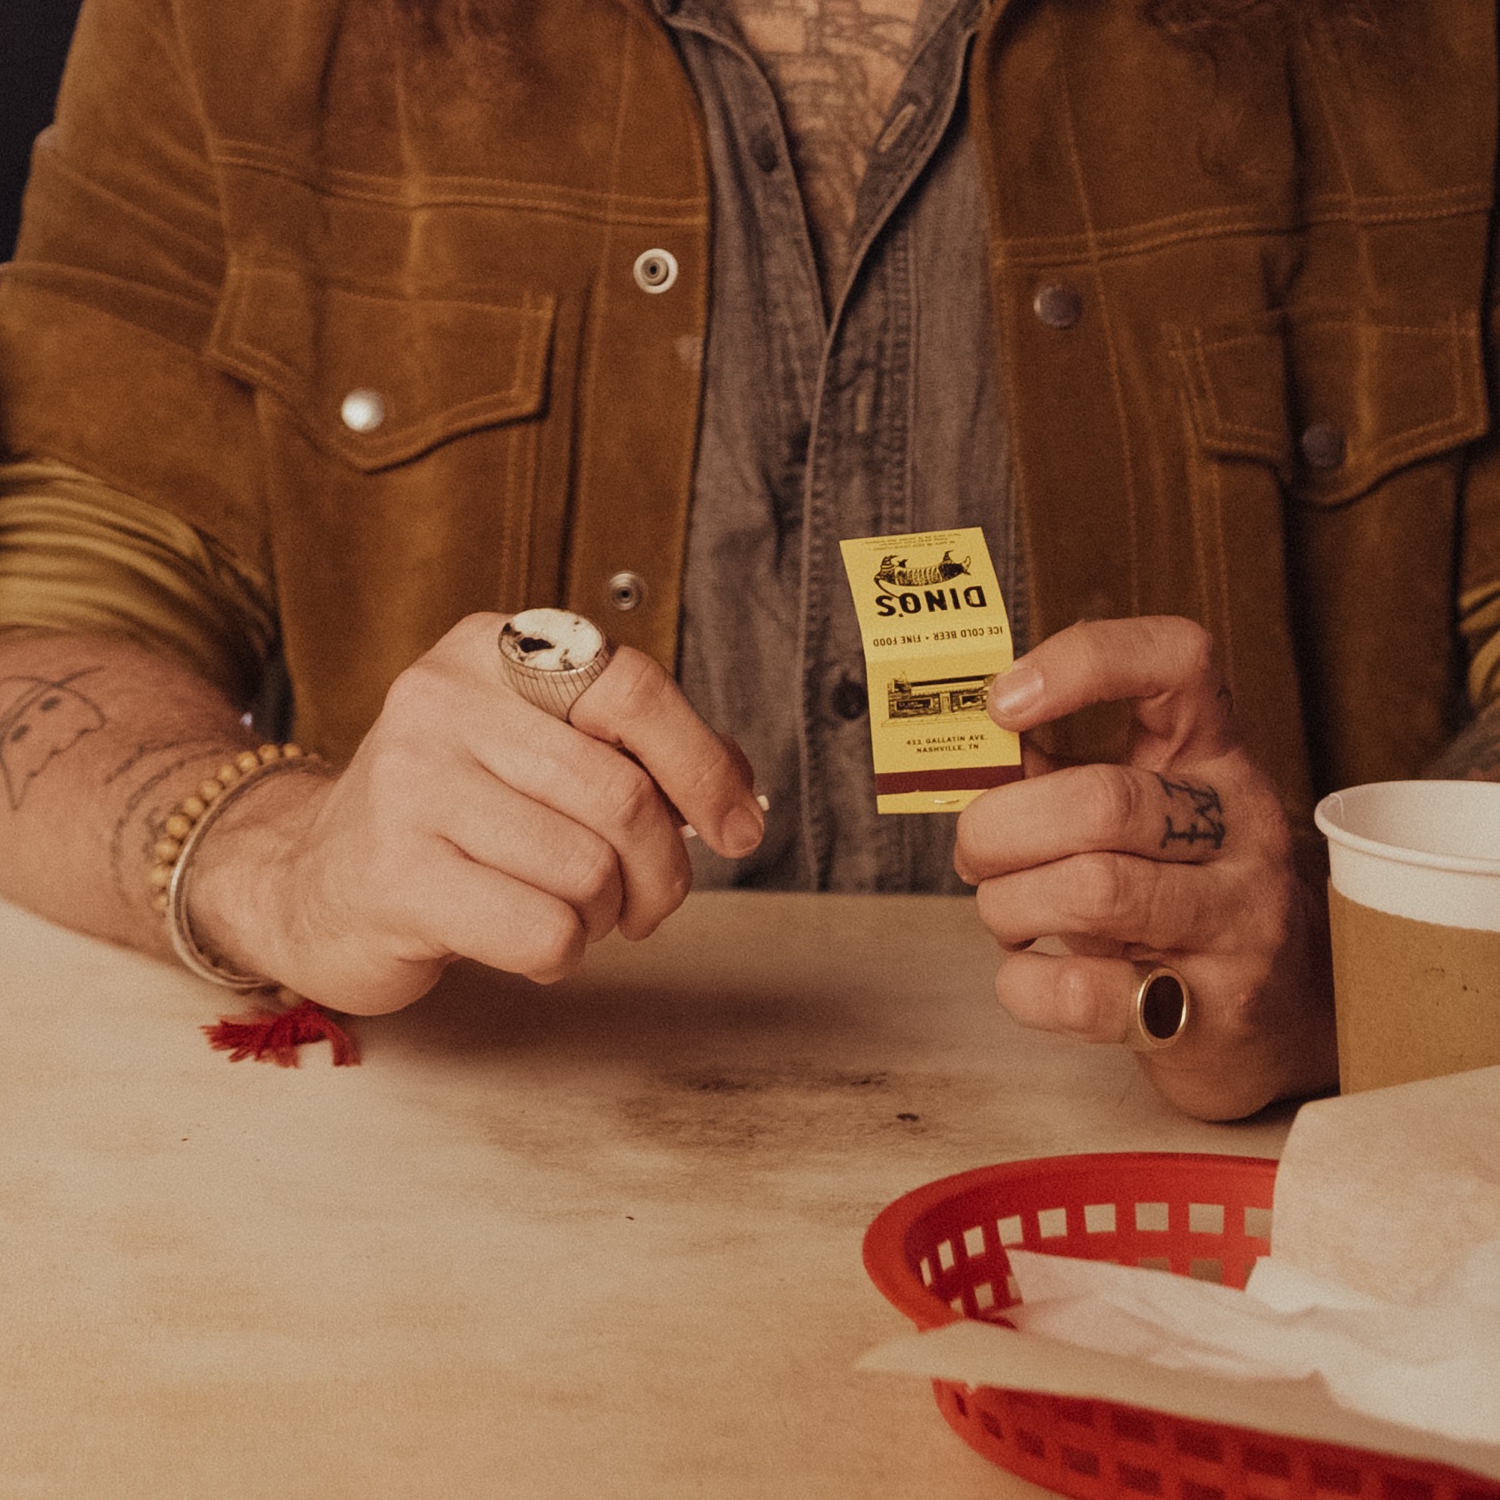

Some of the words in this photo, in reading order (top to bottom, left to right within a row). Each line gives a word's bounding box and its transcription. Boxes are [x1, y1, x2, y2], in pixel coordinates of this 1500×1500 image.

[960, 627, 985, 638] COLD
[988, 625, 1003, 635] ICE
[901, 634, 921, 644] FINE
[933, 630, 957, 641] BEER
[872, 636, 897, 647] FOOD
[925, 736, 965, 744] GALLATIN
